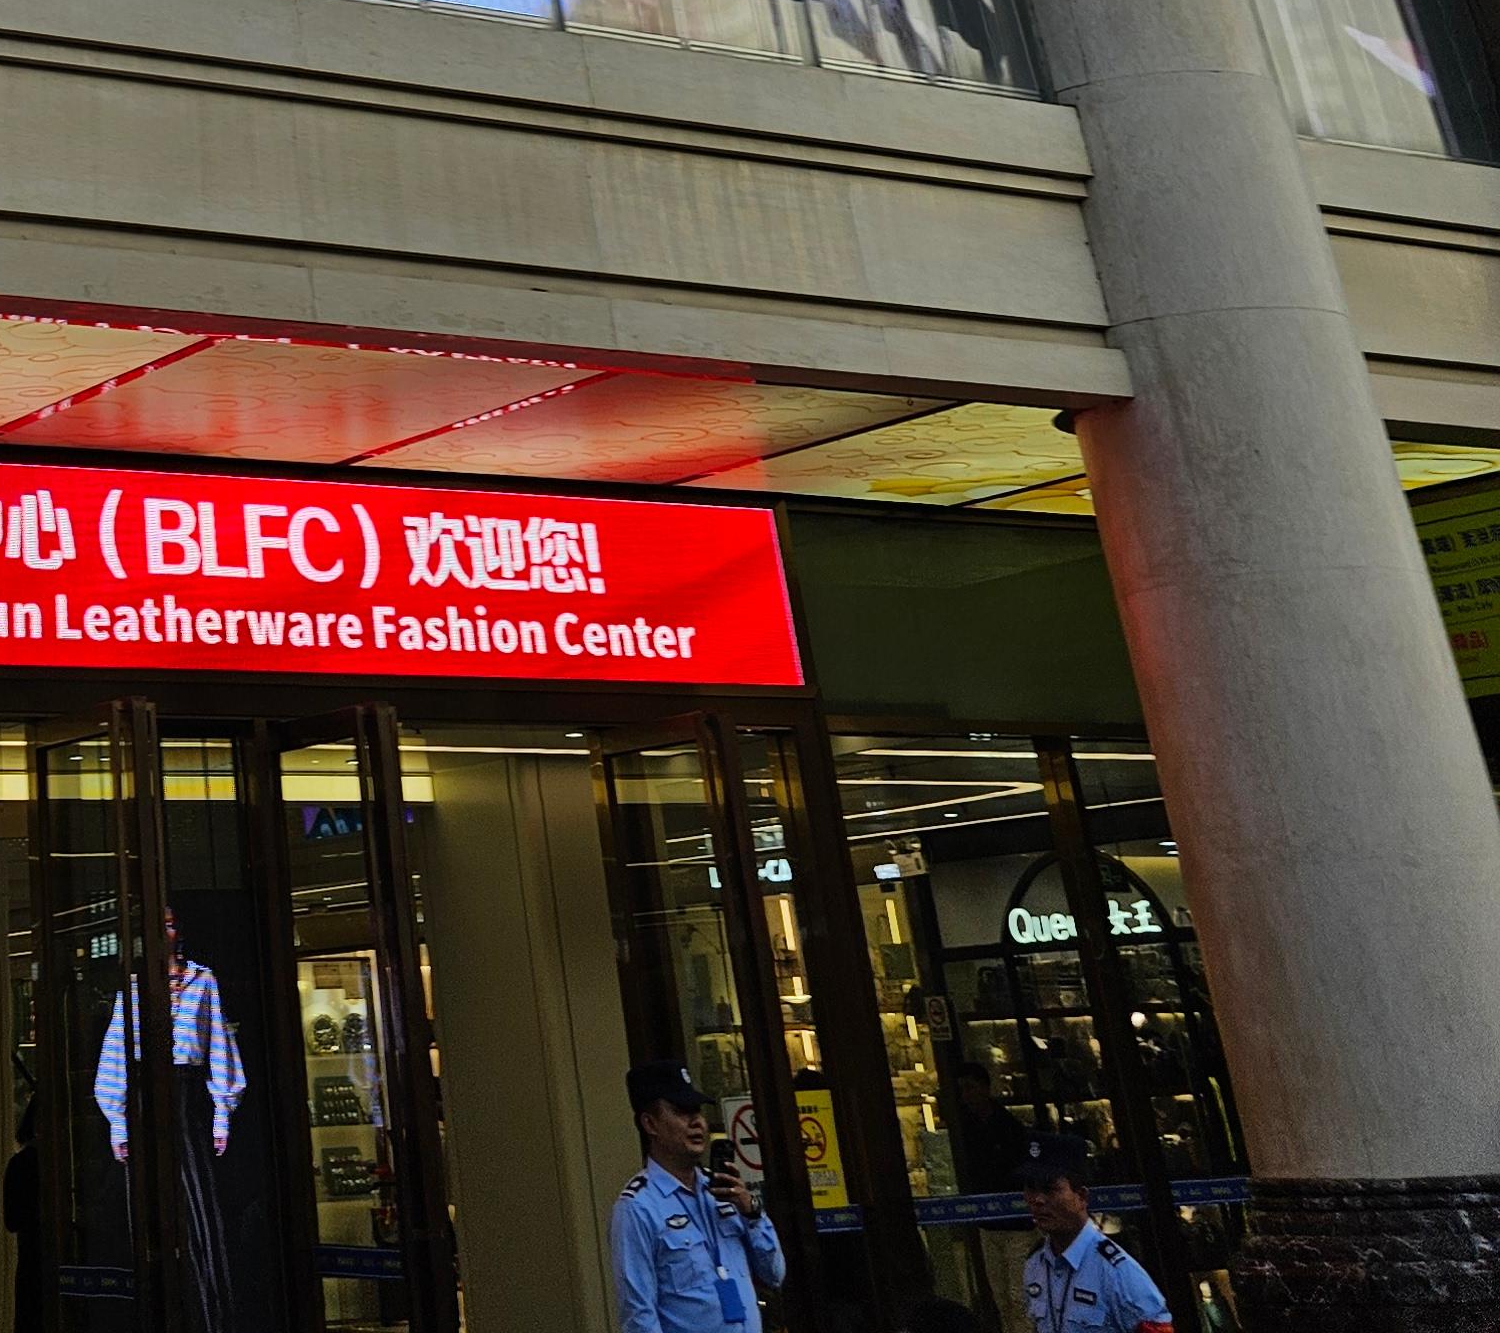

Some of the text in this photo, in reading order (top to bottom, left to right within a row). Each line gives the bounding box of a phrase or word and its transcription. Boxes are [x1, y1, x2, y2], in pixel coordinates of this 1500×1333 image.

[55, 594, 364, 649] Leatherware
[372, 605, 548, 654] Fashion
[554, 612, 696, 659] Center
[1107, 899, 1163, 935] 女王
